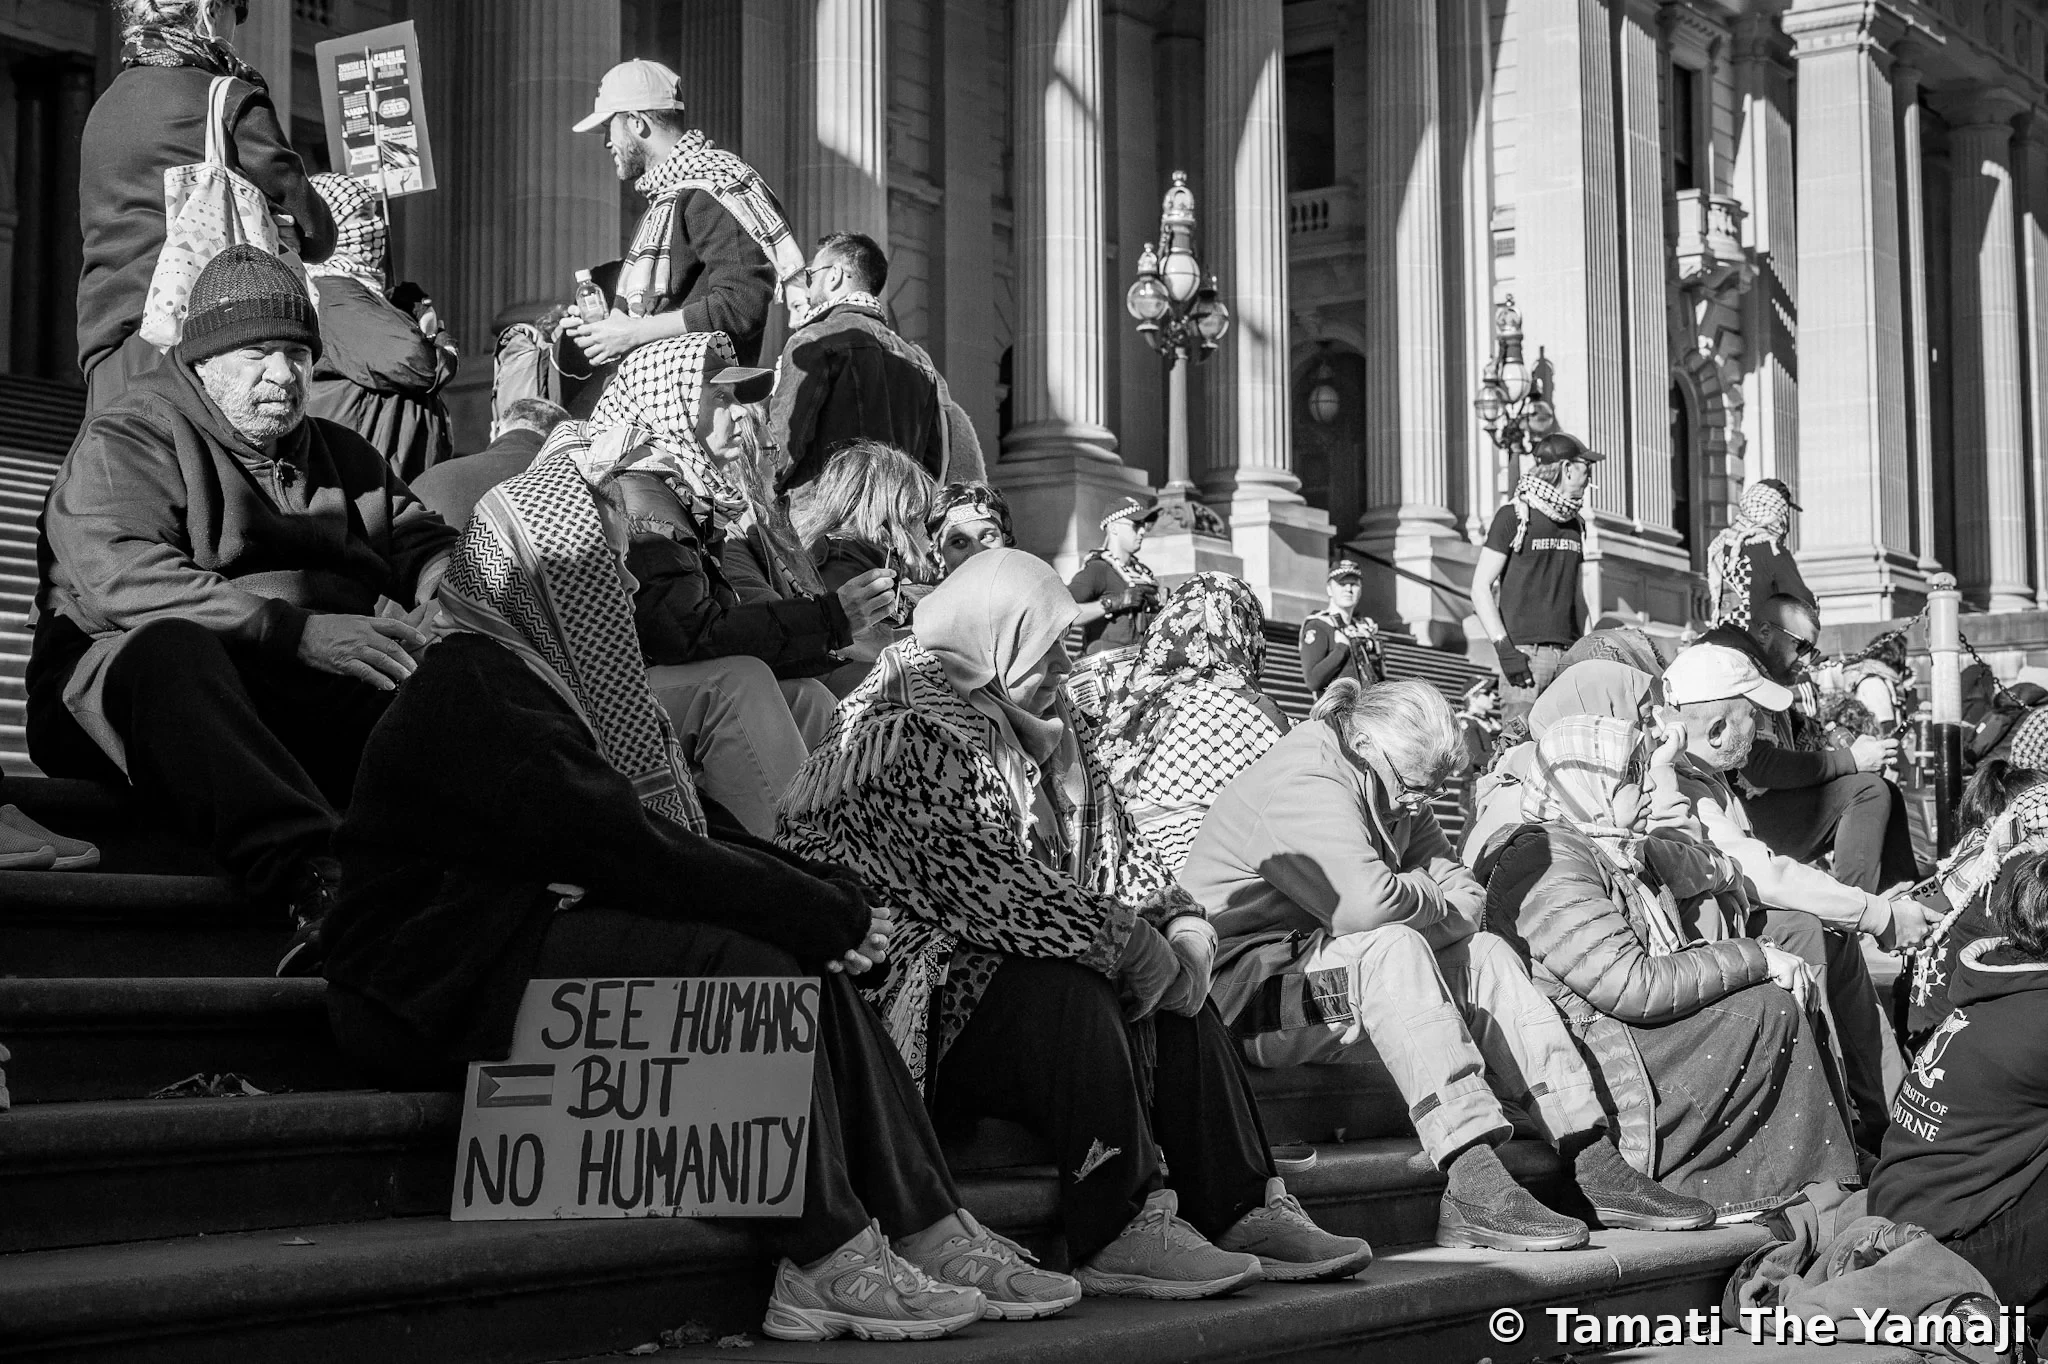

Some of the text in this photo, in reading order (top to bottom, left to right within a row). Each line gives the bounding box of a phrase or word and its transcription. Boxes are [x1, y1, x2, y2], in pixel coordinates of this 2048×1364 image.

[1532, 538, 1549, 550] FREE
[541, 980, 819, 1055] SEE HUMANS
[567, 1055, 690, 1120] BUT
[1930, 1101, 1949, 1117] OF
[464, 1116, 805, 1210] NO HUMANITY
[956, 1259, 989, 1284] N
[845, 1276, 880, 1302] N
